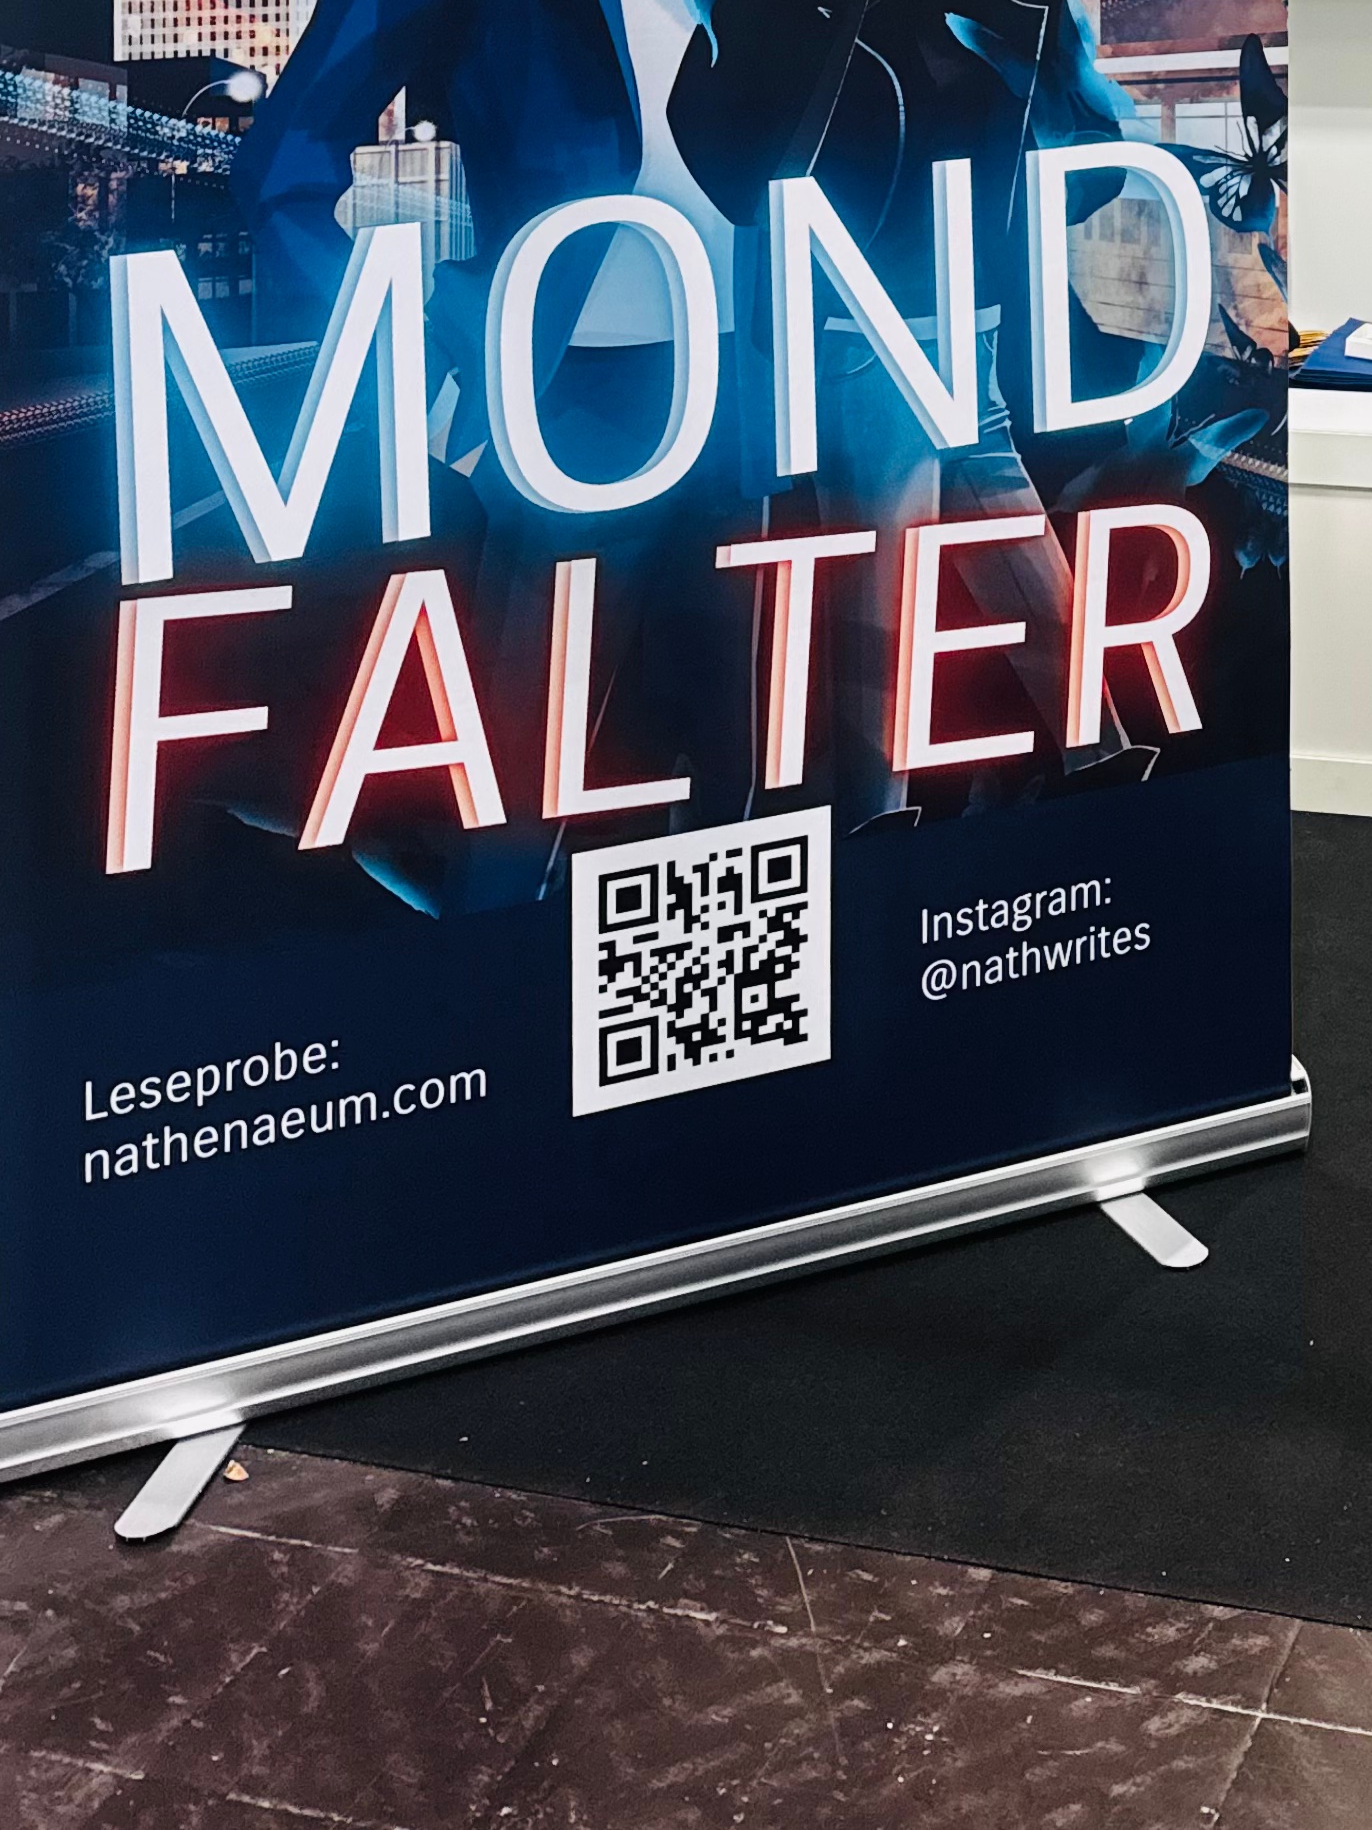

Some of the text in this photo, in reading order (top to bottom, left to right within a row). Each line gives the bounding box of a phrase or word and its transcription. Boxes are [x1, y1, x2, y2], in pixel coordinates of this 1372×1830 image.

[109, 140, 1213, 585] MOND
[106, 504, 1215, 875] FALTER
[921, 877, 1111, 944] Instagram:
[921, 922, 1151, 1001] @nathwrites
[84, 1068, 487, 1183] nathenaeum.com
[85, 1039, 339, 1121] Leseprobe:
